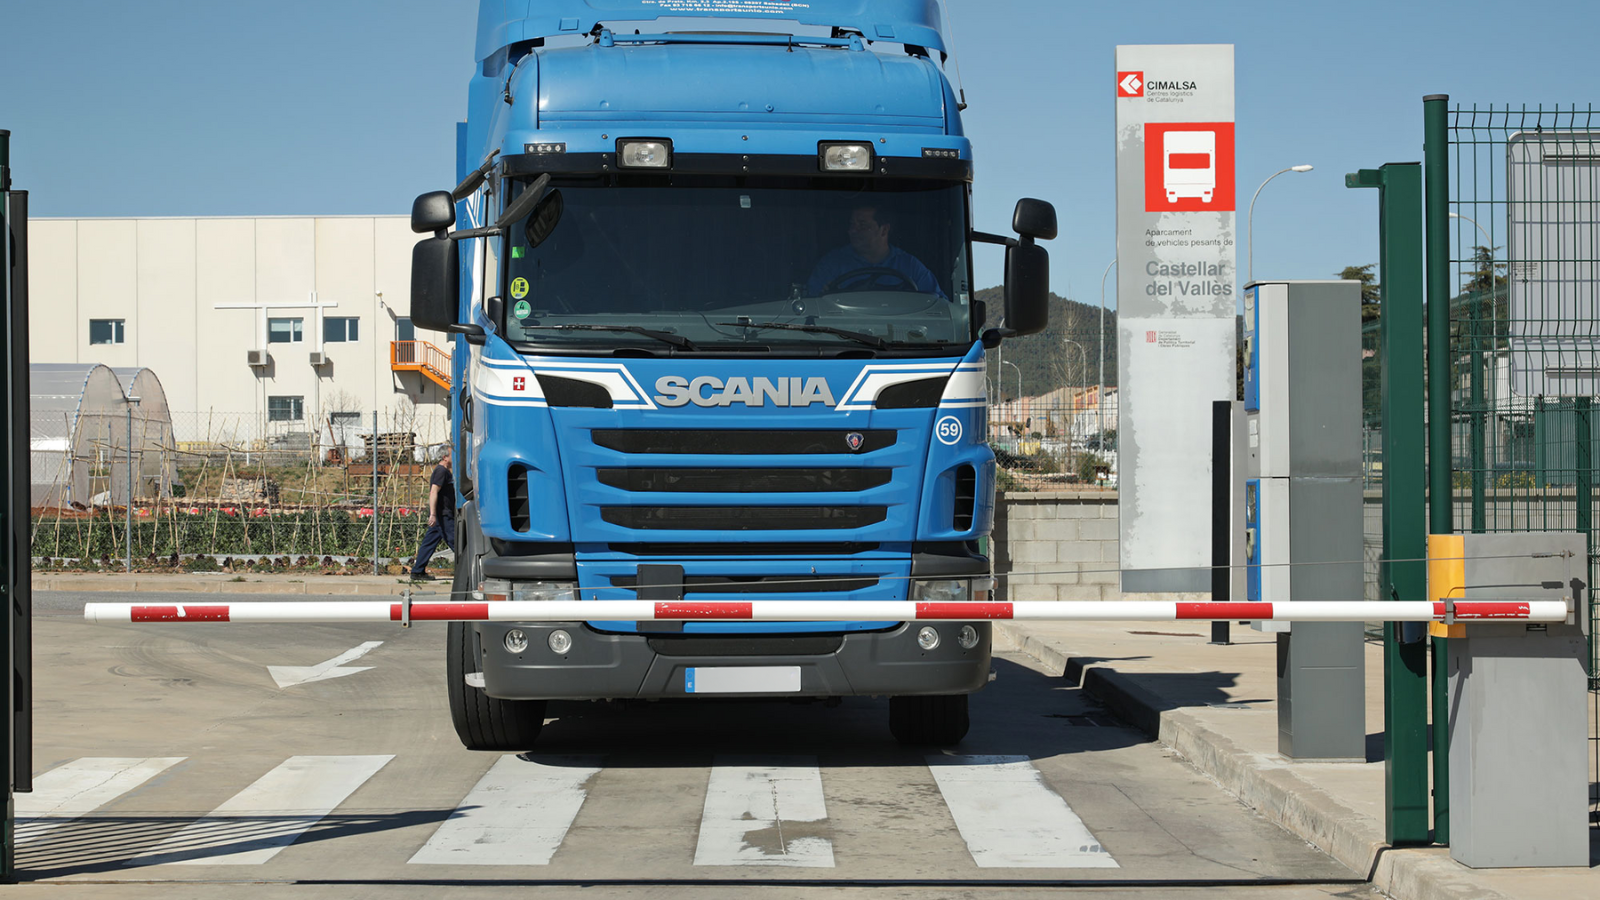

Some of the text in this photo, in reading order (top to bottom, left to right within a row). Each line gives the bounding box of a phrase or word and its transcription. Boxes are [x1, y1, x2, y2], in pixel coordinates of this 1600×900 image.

[1147, 81, 1197, 90] CIMALSA
[1145, 229, 1192, 237] Aparcament
[1224, 238, 1233, 246] de
[1146, 261, 1225, 276] Castellar
[1146, 280, 1232, 296] del Vallès
[654, 375, 837, 408] SCANIA
[940, 422, 958, 437] 59
